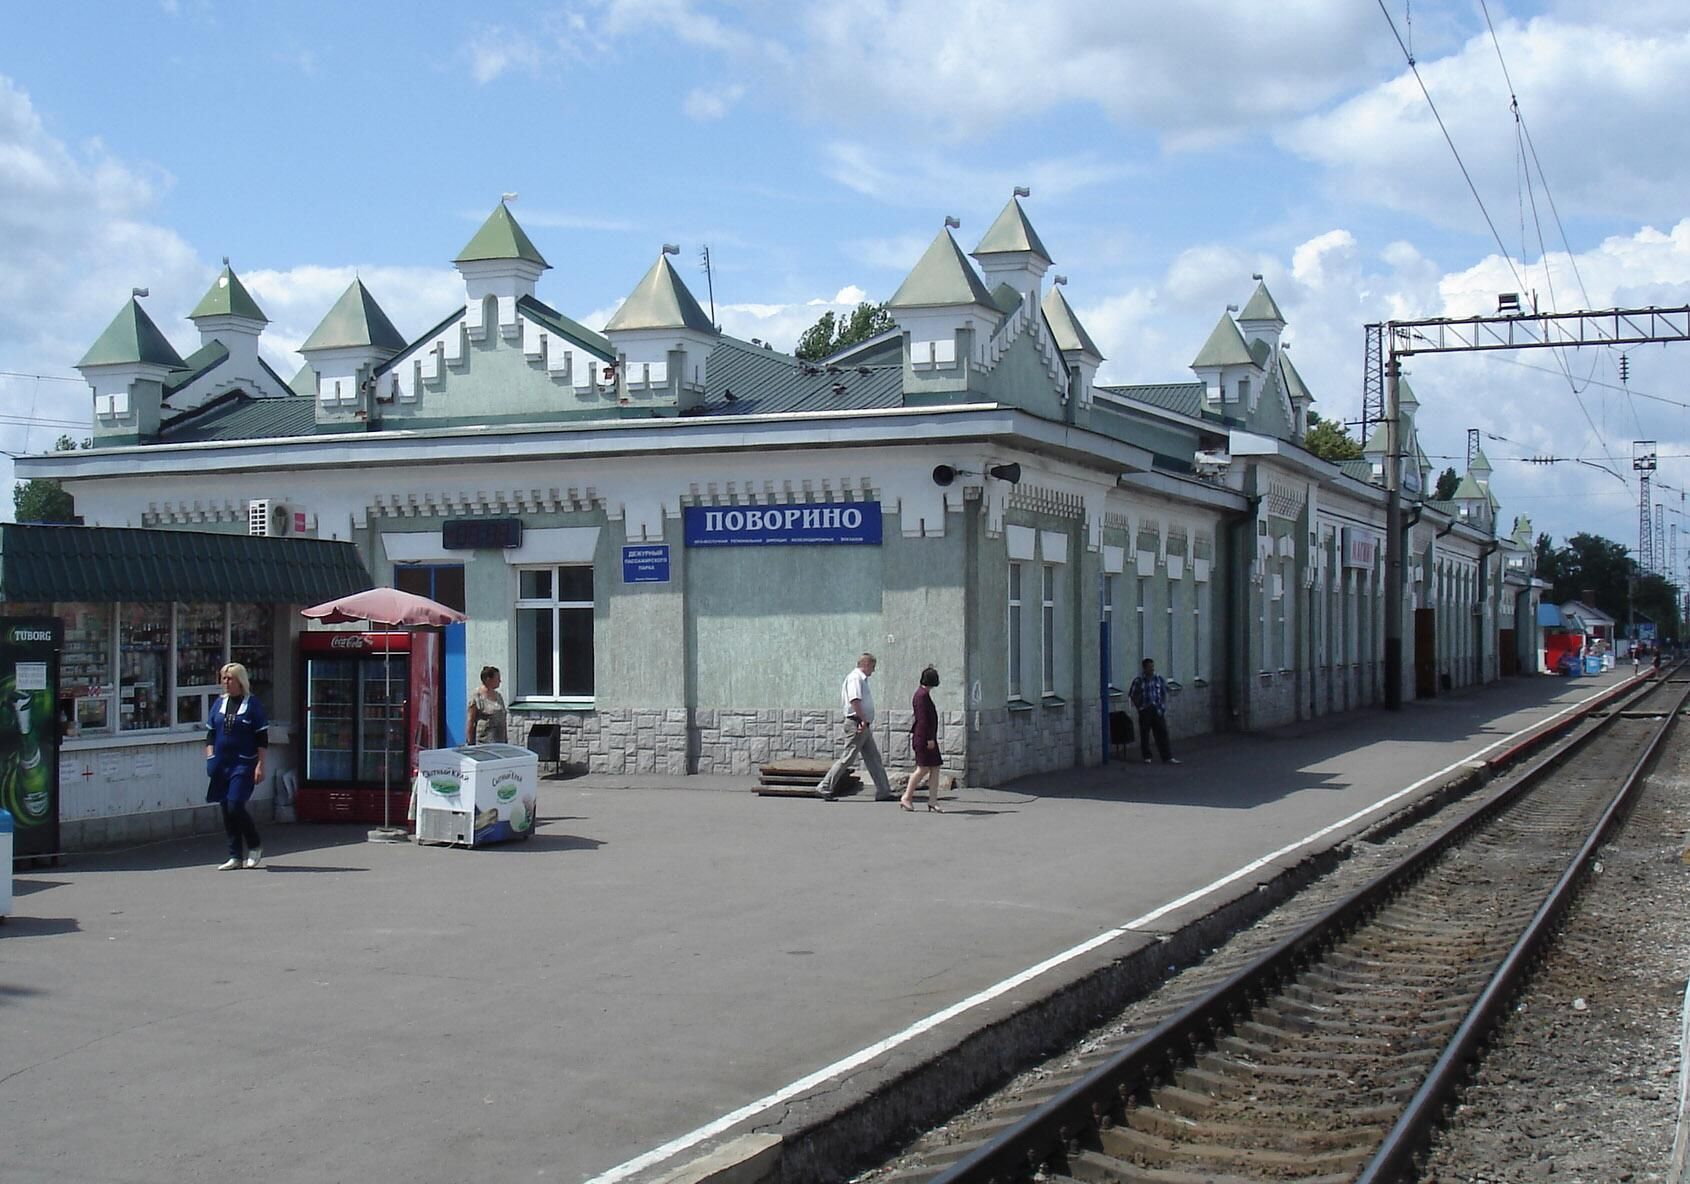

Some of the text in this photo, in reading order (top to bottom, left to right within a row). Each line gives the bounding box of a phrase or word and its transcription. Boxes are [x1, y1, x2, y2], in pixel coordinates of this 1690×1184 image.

[705, 508, 862, 531] ПОВОРИНО
[14, 630, 51, 641] TUBORG
[331, 635, 364, 648] Coca-Cola
